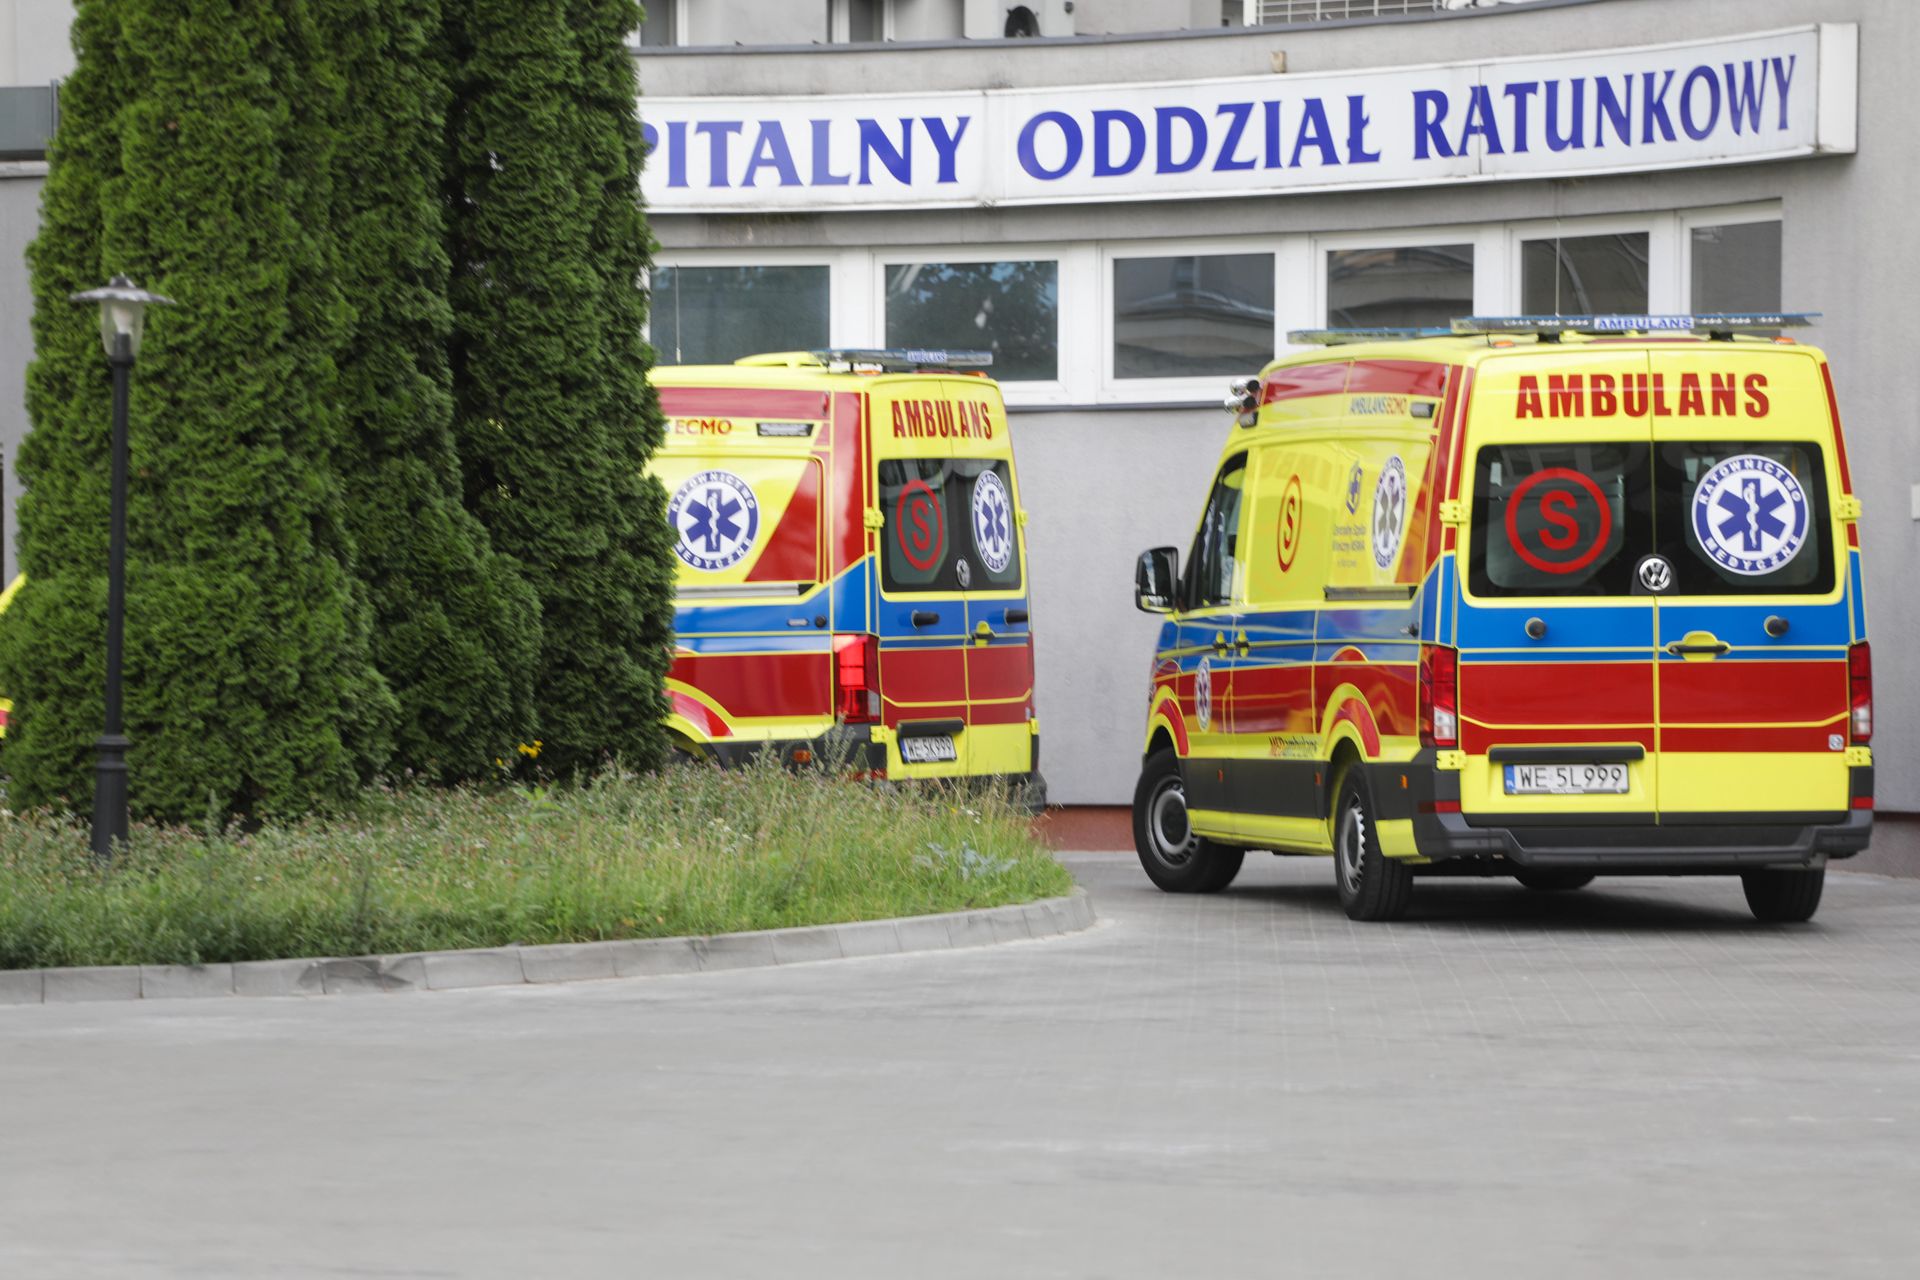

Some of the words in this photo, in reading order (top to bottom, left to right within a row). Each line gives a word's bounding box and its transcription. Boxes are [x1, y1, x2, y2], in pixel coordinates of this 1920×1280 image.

[1016, 95, 1381, 181] ODDZIAŁ
[1411, 54, 1796, 160] RATUNKOWY
[1599, 319, 1693, 330] AMBULANS
[1516, 373, 1770, 419] AMBULANS
[675, 418, 732, 435] ECMO
[891, 399, 992, 439] AMBULANS
[911, 497, 931, 551] S
[1539, 489, 1579, 551] S
[1520, 767, 1548, 788] WE
[1556, 767, 1622, 788] 5L999
